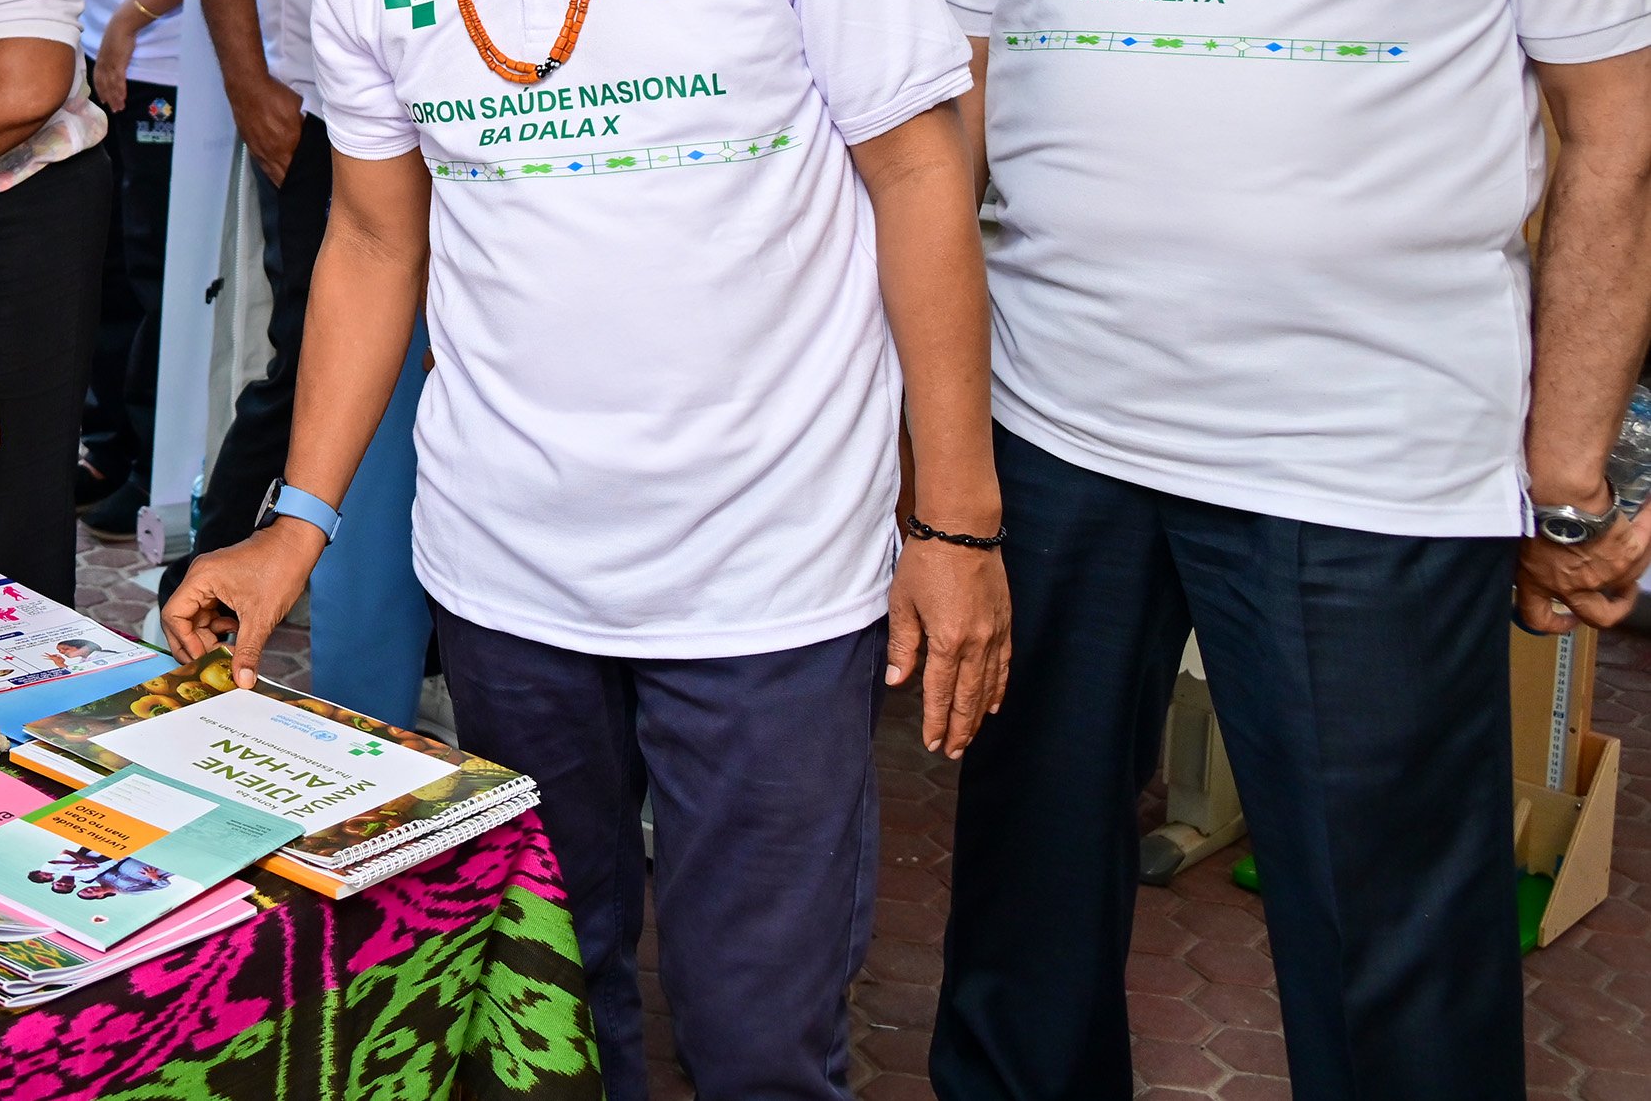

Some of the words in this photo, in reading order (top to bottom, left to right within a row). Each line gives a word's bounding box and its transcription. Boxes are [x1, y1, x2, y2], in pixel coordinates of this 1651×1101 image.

[405, 99, 475, 125] LORON
[480, 87, 573, 119] SAÚDE
[579, 73, 727, 107] NASIONAL
[478, 127, 513, 147] BA
[518, 116, 597, 142] DALA
[600, 115, 621, 136] X
[209, 739, 336, 788] AI-HAN
[192, 757, 302, 804] IJIENE
[236, 790, 279, 810] kona-ba
[283, 780, 376, 818] MANUAL
[64, 810, 87, 823] Oan
[75, 805, 106, 820] LISIO
[88, 821, 104, 829] no
[104, 827, 130, 841] Inan
